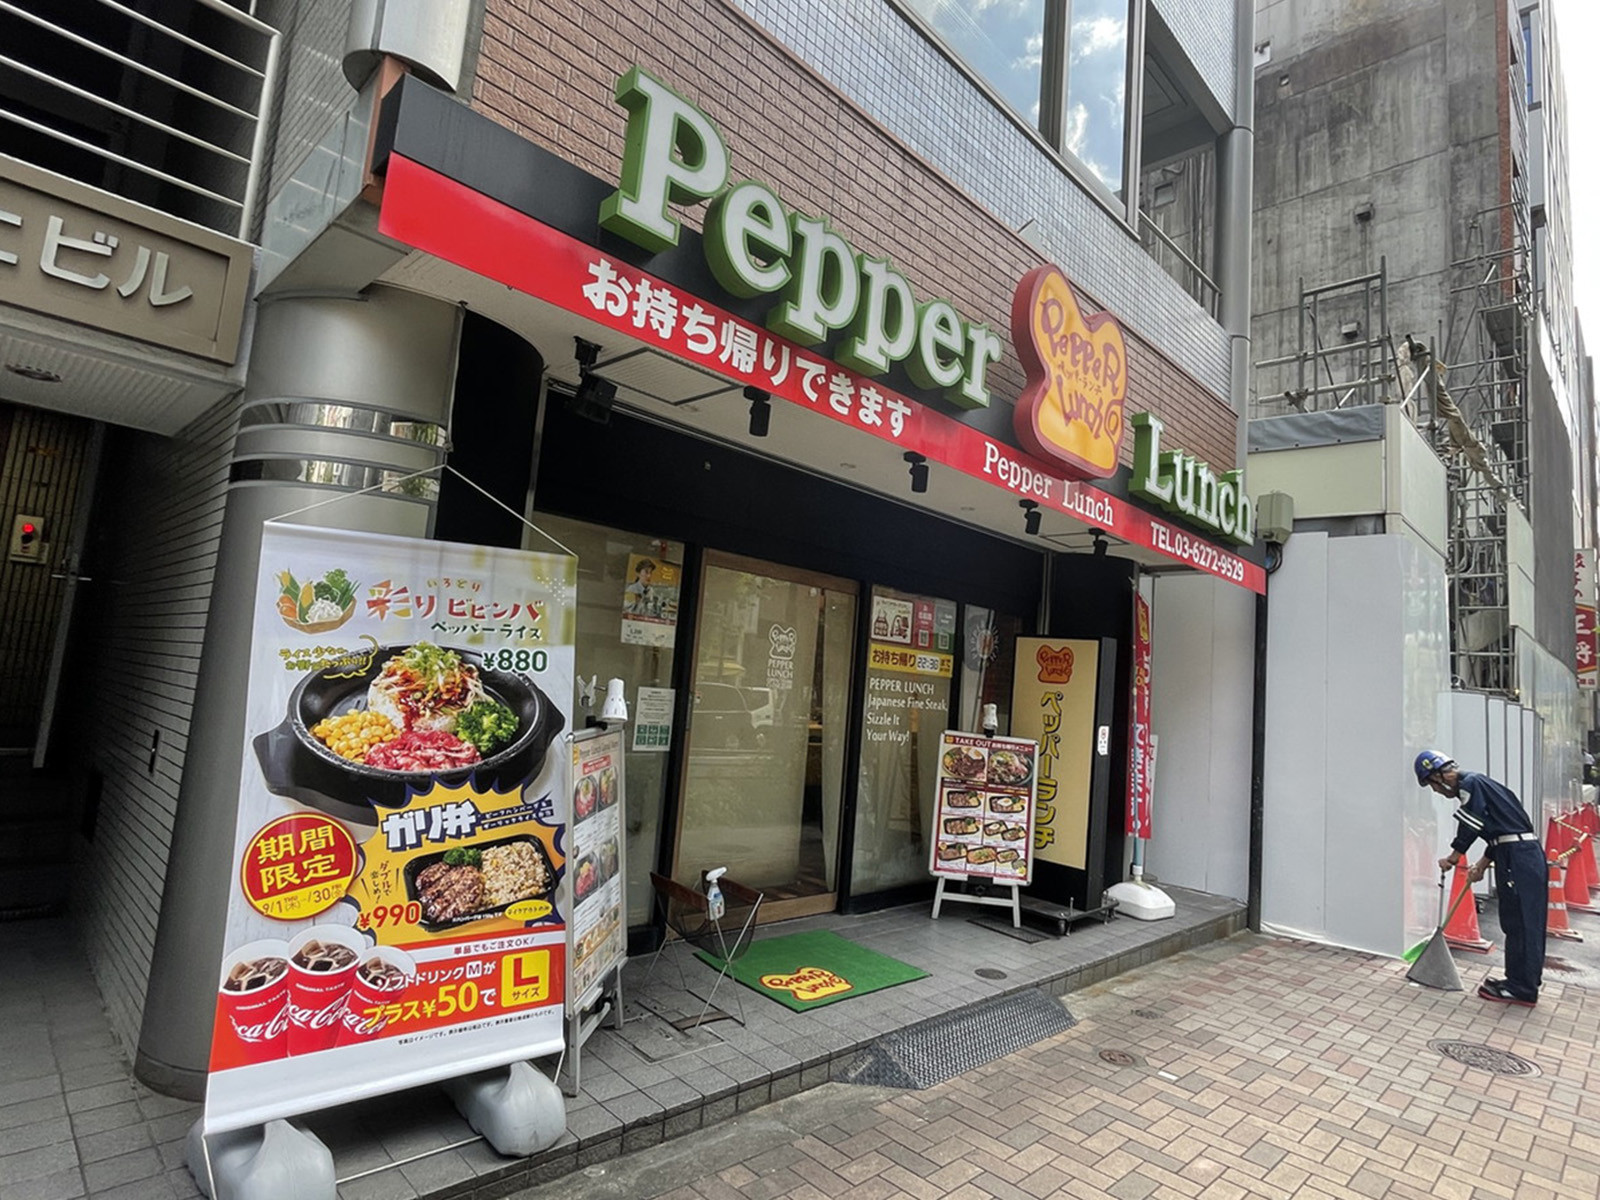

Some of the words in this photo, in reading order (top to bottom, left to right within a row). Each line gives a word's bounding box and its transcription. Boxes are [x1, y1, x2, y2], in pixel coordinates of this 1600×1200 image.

[601, 65, 1001, 411] Pepper
[582, 258, 912, 438] お持ち帰りできます
[984, 442, 1052, 500] Pepper
[1063, 487, 1114, 528] Lunch
[1130, 412, 1255, 547] Lunch
[1151, 521, 1245, 583] TEL.03-6272-9529
[427, 577, 481, 593] いろどり
[431, 622, 542, 641] ペッパーライス
[483, 647, 549, 673] ¥880
[869, 677, 901, 692] PEPPER
[904, 681, 934, 695] LUNCH
[867, 693, 905, 710] Japanese
[866, 712, 891, 725] Sizzle
[866, 728, 887, 741] Your
[889, 729, 910, 746] Way!
[955, 737, 974, 746] TAKE
[975, 739, 992, 748] OUT
[1034, 690, 1064, 850] ペッパーランチ
[382, 800, 478, 850] ガリ弁
[256, 824, 335, 865] 期間
[259, 854, 340, 894] 限定
[360, 902, 420, 929] ¥990
[513, 958, 539, 987] L
[512, 986, 540, 1001] サイズ
